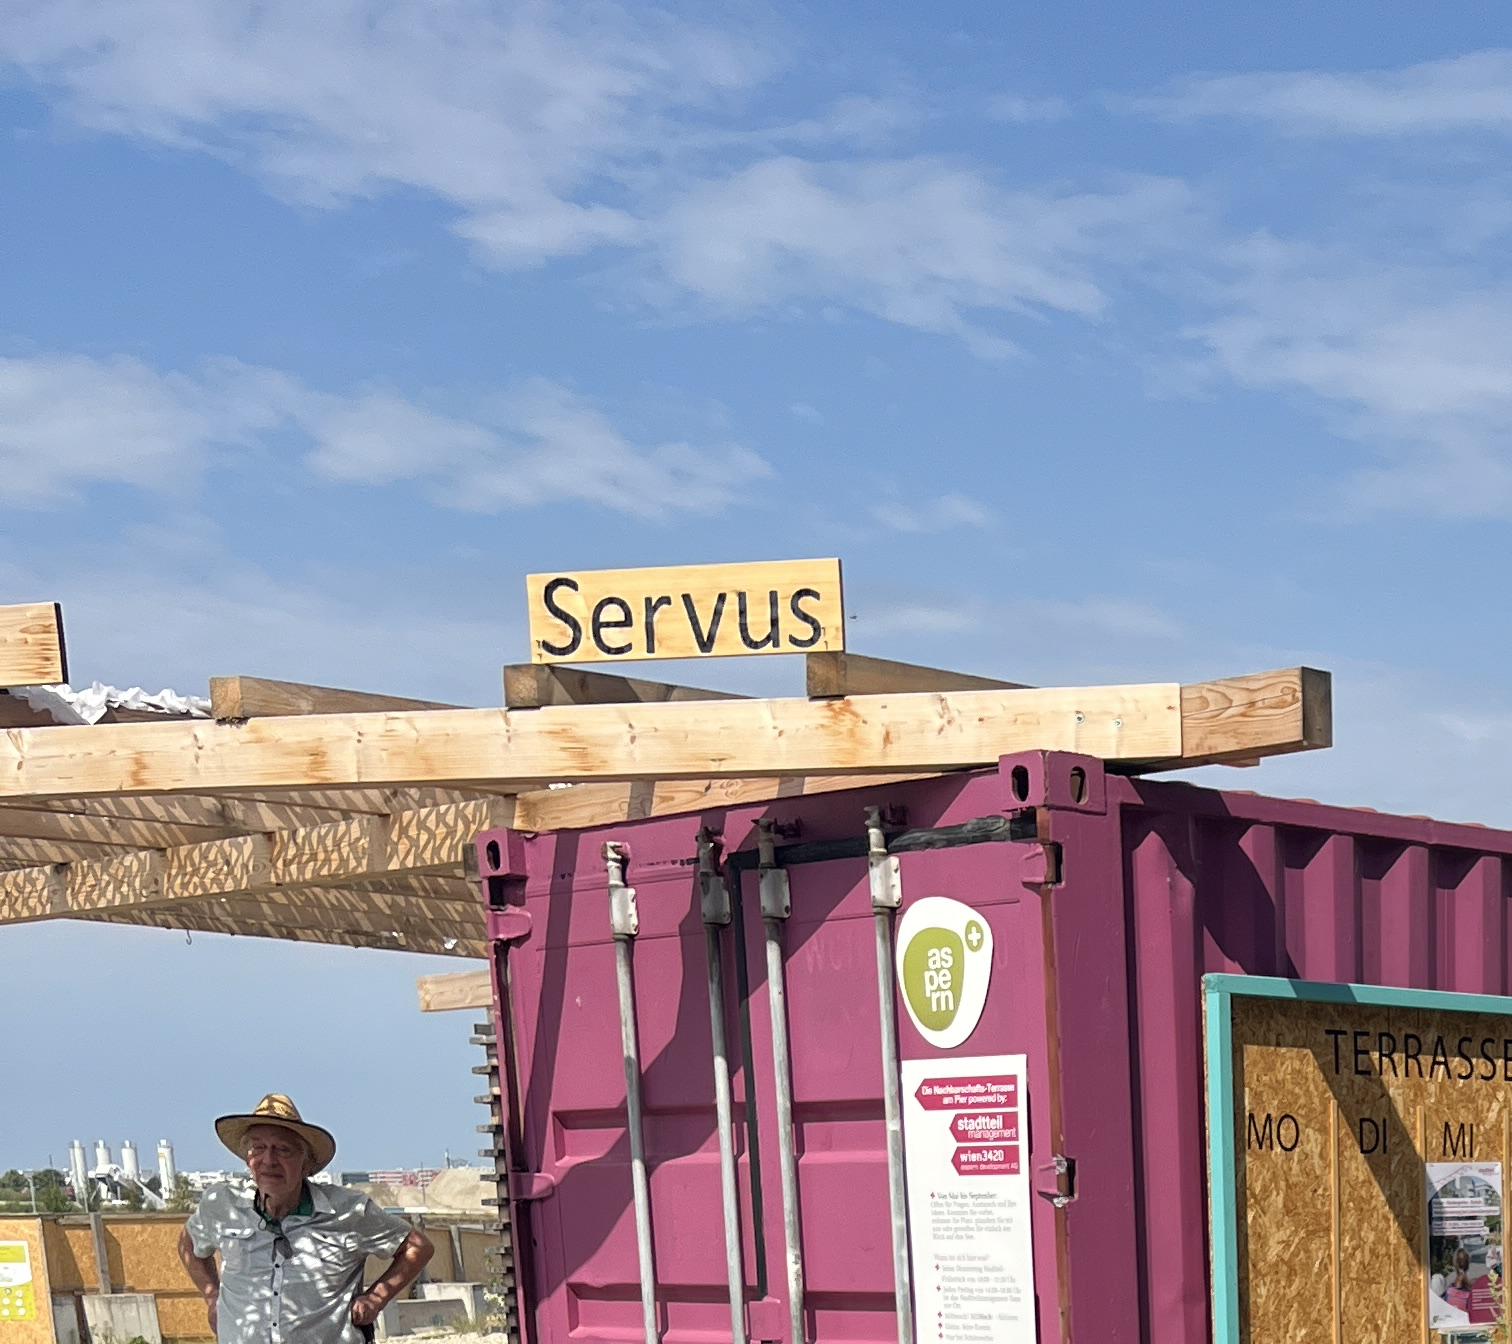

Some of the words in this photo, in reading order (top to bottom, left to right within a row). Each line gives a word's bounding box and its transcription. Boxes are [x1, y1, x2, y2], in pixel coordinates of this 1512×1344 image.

[542, 577, 822, 656] Servus
[927, 946, 954, 970] as
[924, 969, 952, 997] pe
[929, 990, 954, 1013] rn
[957, 1115, 1003, 1131] stadtteil
[967, 1127, 1017, 1141] management
[1247, 1112, 1300, 1152] MO
[1359, 1117, 1387, 1155] DI
[1442, 1121, 1474, 1158] MI
[959, 1149, 1005, 1162] wien3420
